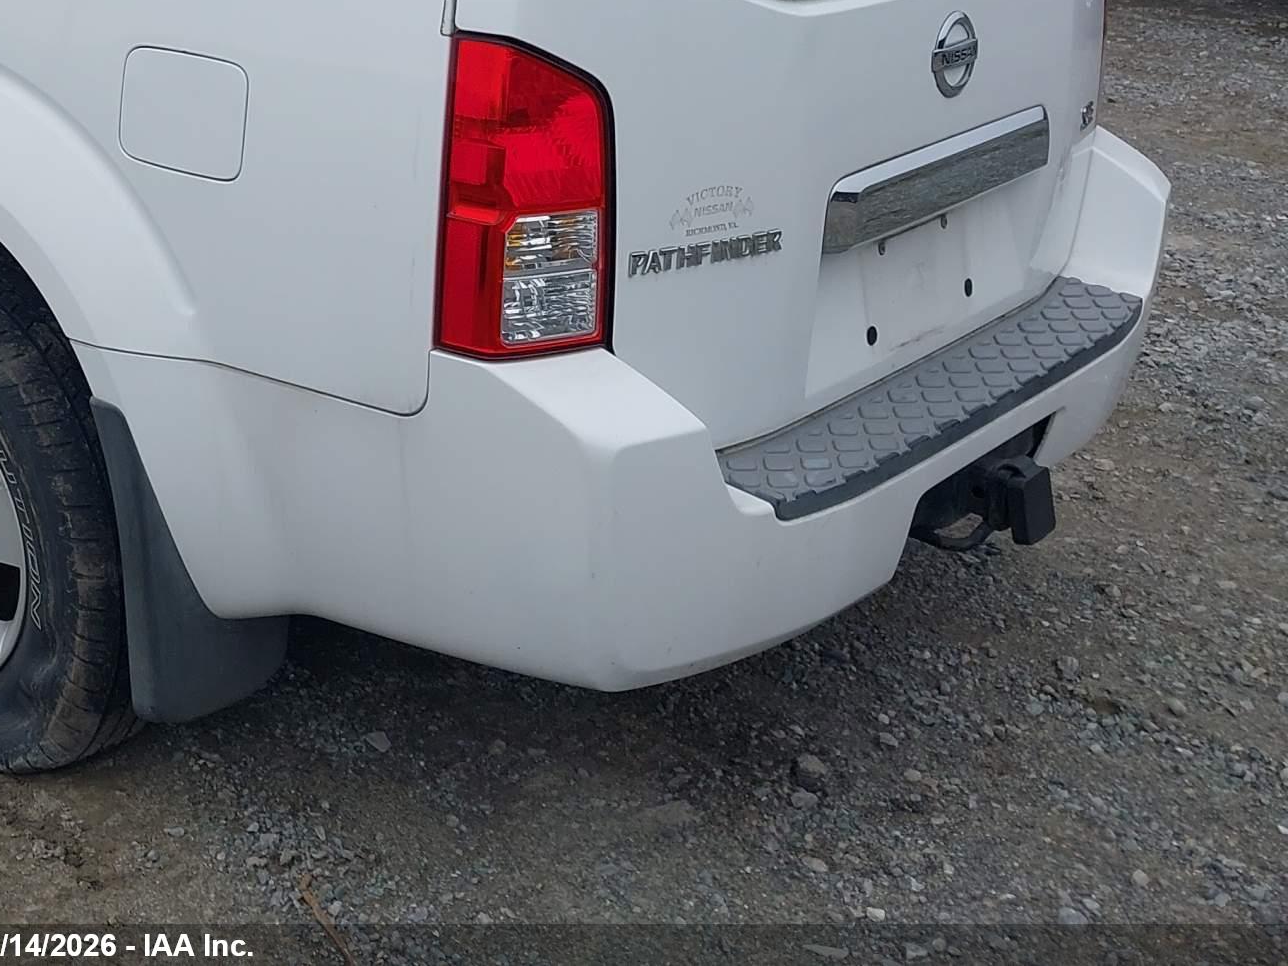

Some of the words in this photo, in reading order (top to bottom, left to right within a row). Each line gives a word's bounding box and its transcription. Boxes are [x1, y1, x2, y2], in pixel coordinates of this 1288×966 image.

[940, 42, 979, 67] NISSAN
[686, 185, 744, 206] VICTORY
[694, 201, 734, 218] NISSAN
[628, 228, 784, 278] PATHFINDER
